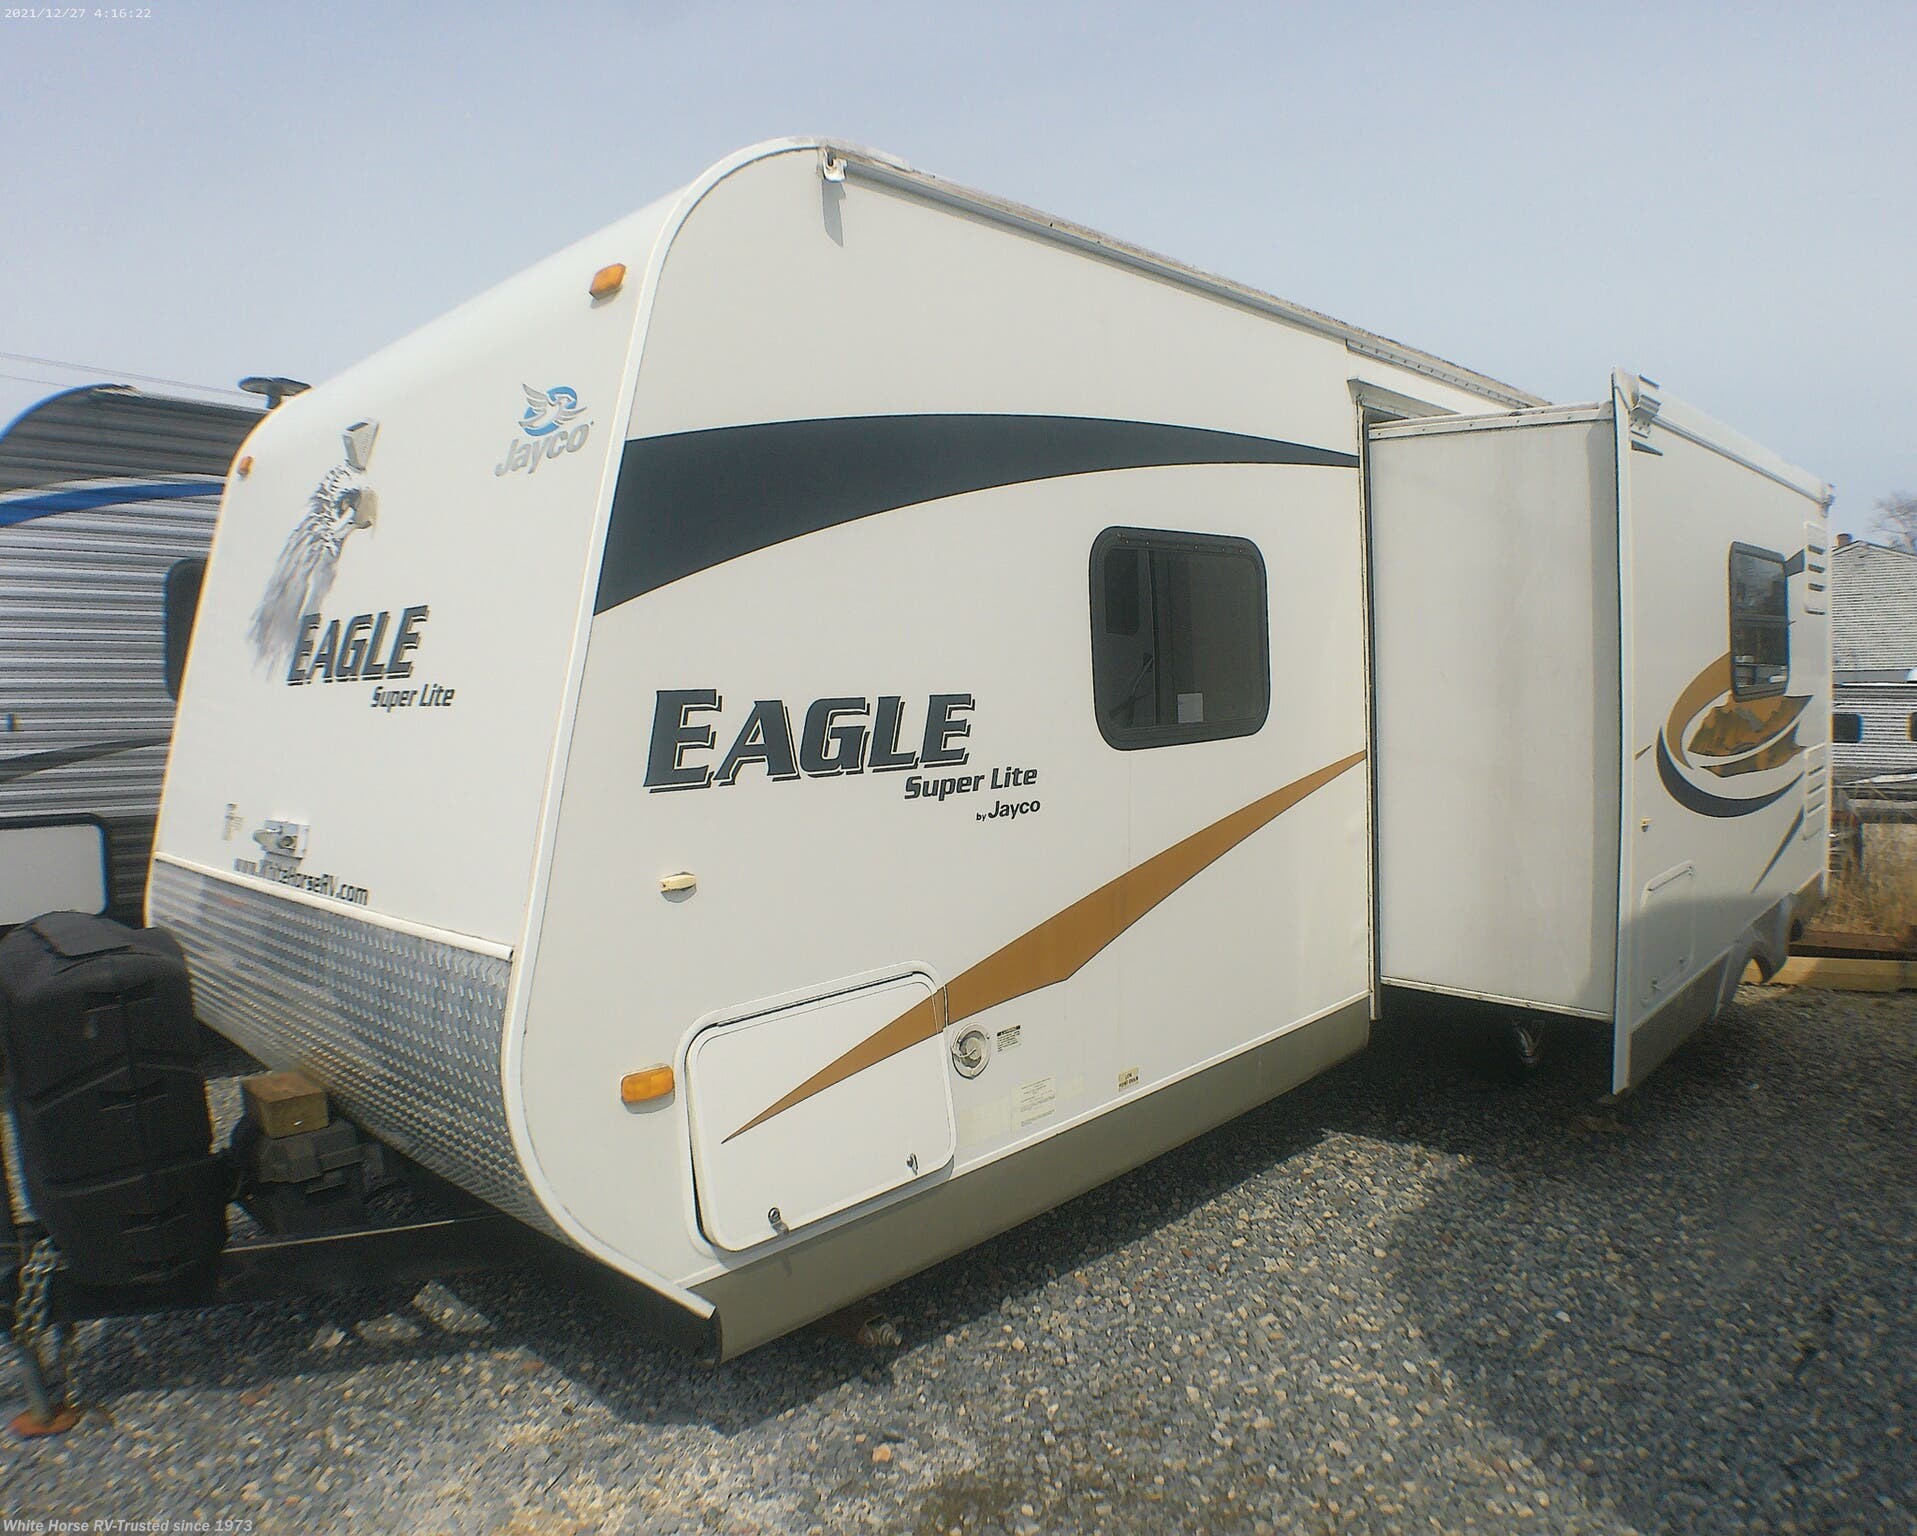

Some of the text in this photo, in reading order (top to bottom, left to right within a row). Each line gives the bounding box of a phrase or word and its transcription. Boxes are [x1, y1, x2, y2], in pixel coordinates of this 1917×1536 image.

[494, 423, 590, 477] Jayco
[286, 604, 429, 686] EAGLE
[370, 683, 456, 713] Super Lite
[643, 688, 976, 794] EAGLE
[904, 766, 1038, 802] Super Lite
[975, 800, 1041, 822] by Jayco
